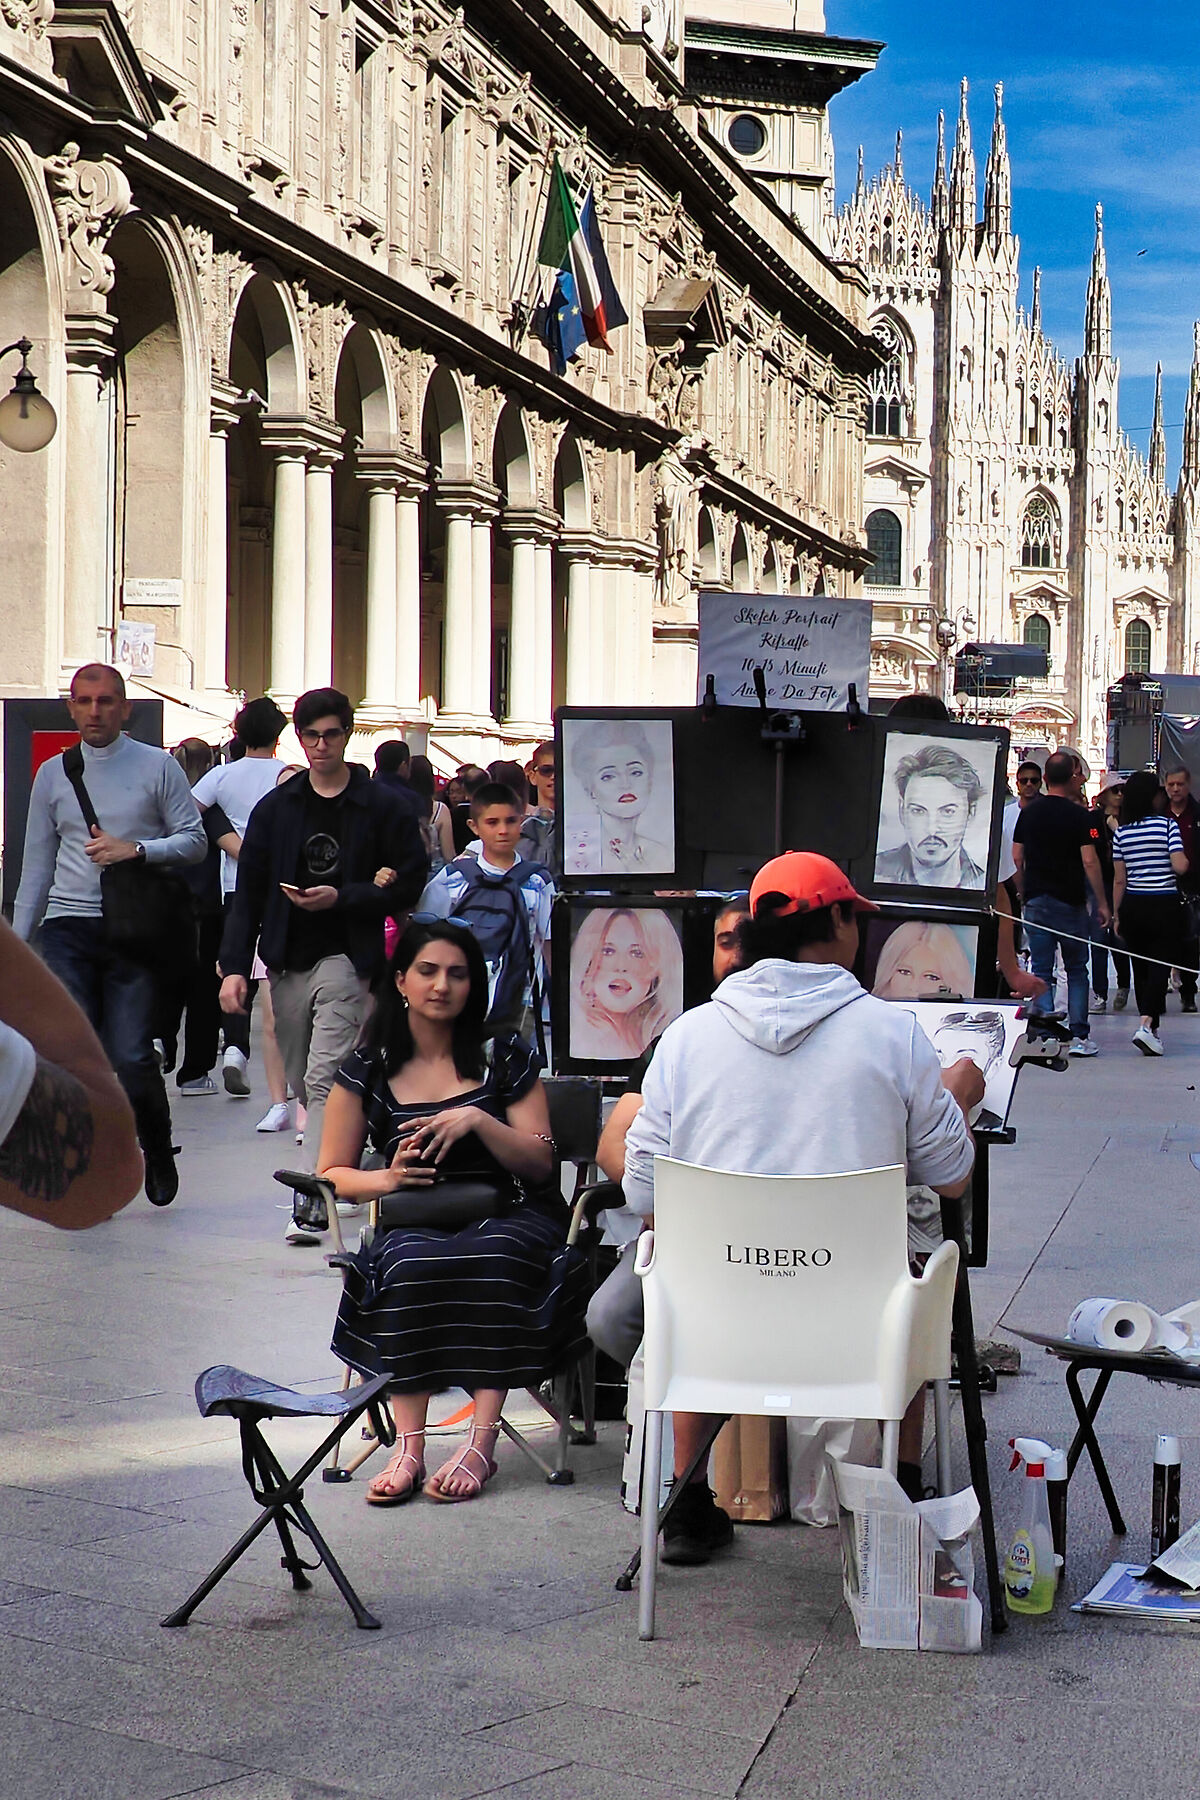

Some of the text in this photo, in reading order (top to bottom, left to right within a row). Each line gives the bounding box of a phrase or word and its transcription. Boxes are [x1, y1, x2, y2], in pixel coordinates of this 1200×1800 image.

[734, 607, 780, 625] Sketch
[778, 658, 829, 678] Minuti
[780, 683, 806, 700] Da
[809, 684, 841, 702] Foto
[725, 1244, 832, 1267] LIBERO
[759, 1268, 796, 1278] MILANO
